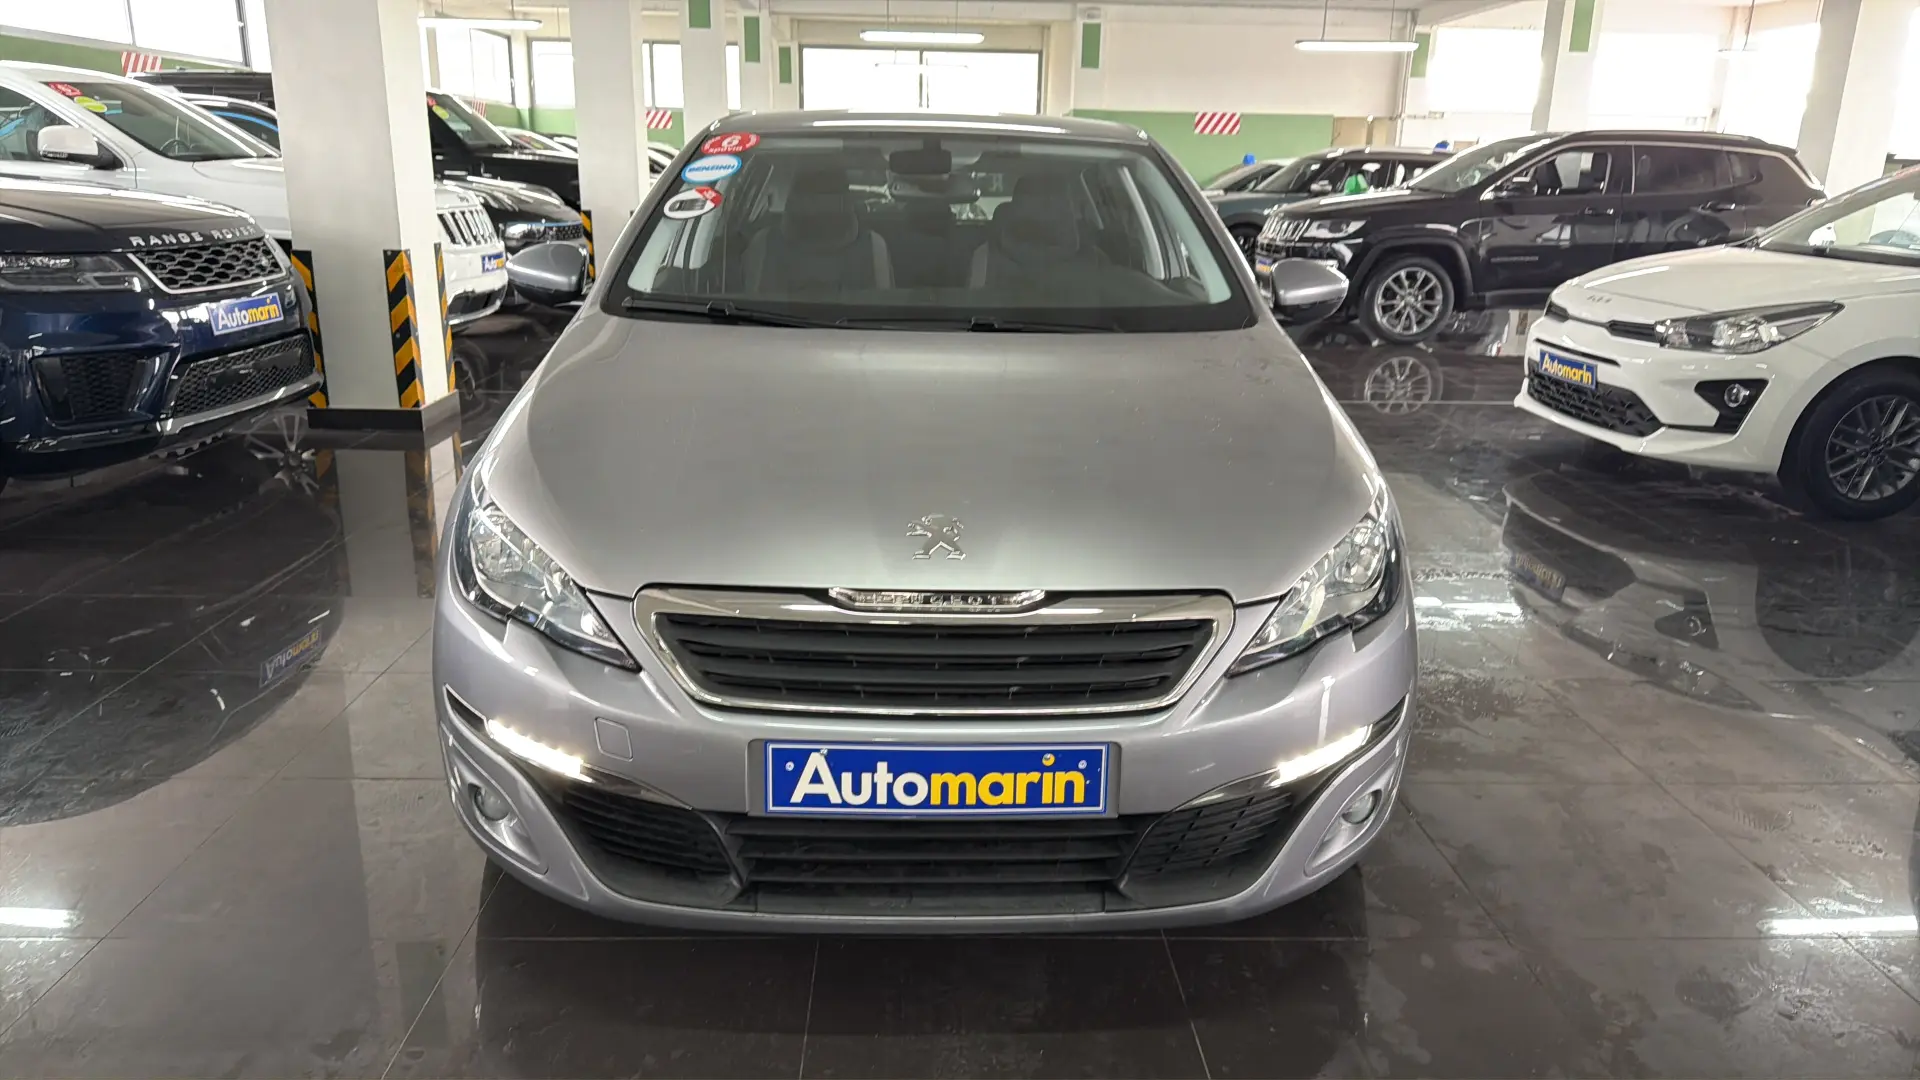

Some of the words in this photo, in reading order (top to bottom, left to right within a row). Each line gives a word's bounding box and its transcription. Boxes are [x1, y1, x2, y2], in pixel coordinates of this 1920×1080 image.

[129, 231, 204, 247] RANGE
[211, 225, 256, 240] ROVER
[218, 296, 279, 330] Automarin
[1542, 353, 1592, 385] Automarin
[790, 751, 1085, 807] Automarin
